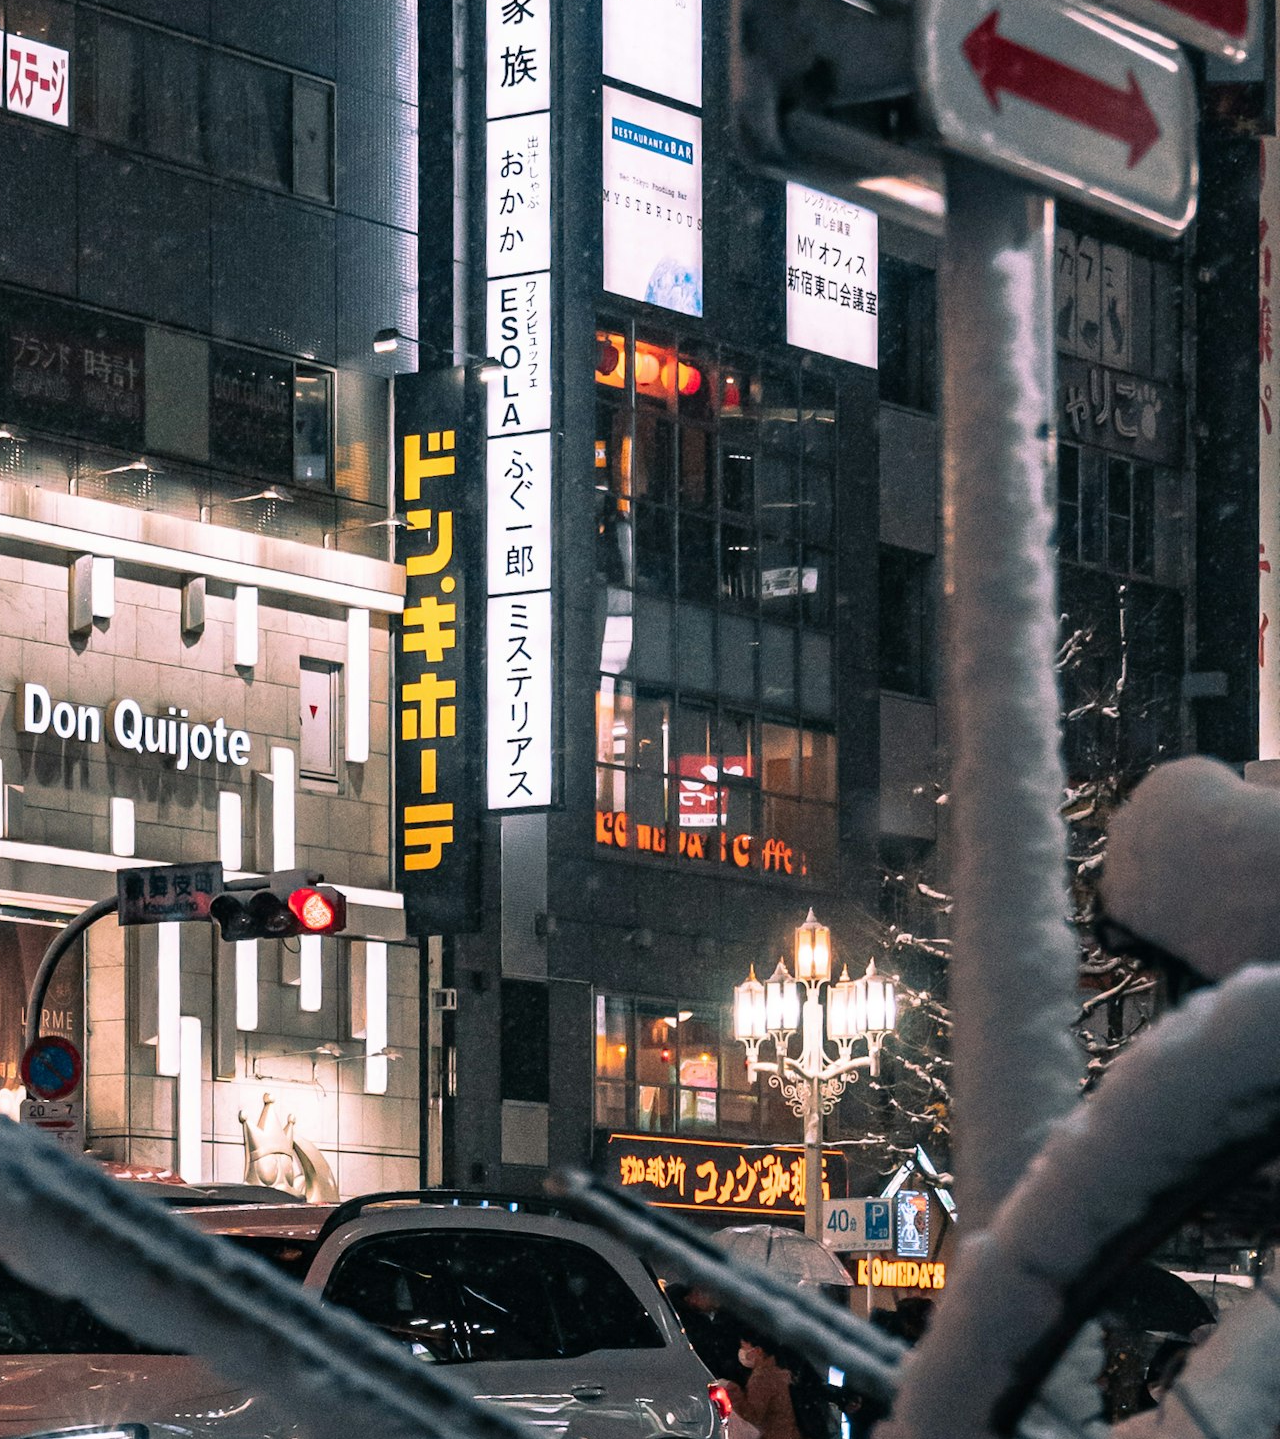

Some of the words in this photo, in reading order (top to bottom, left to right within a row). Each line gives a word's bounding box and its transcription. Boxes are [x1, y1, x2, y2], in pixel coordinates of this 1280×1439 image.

[499, 149, 524, 254] おかか
[603, 189, 703, 232] MYSTERIOUS
[797, 233, 815, 259] MY
[819, 242, 867, 277] オフィス
[788, 265, 877, 317] 新宿東口会議室
[501, 288, 521, 427] ESOLA
[504, 450, 534, 577] ふぐ一郎
[24, 682, 100, 744] Don
[113, 697, 252, 771] Quijote
[506, 603, 534, 799] ミステリアス
[21, 1006, 73, 1031] LRME
[872, 1204, 885, 1227] P
